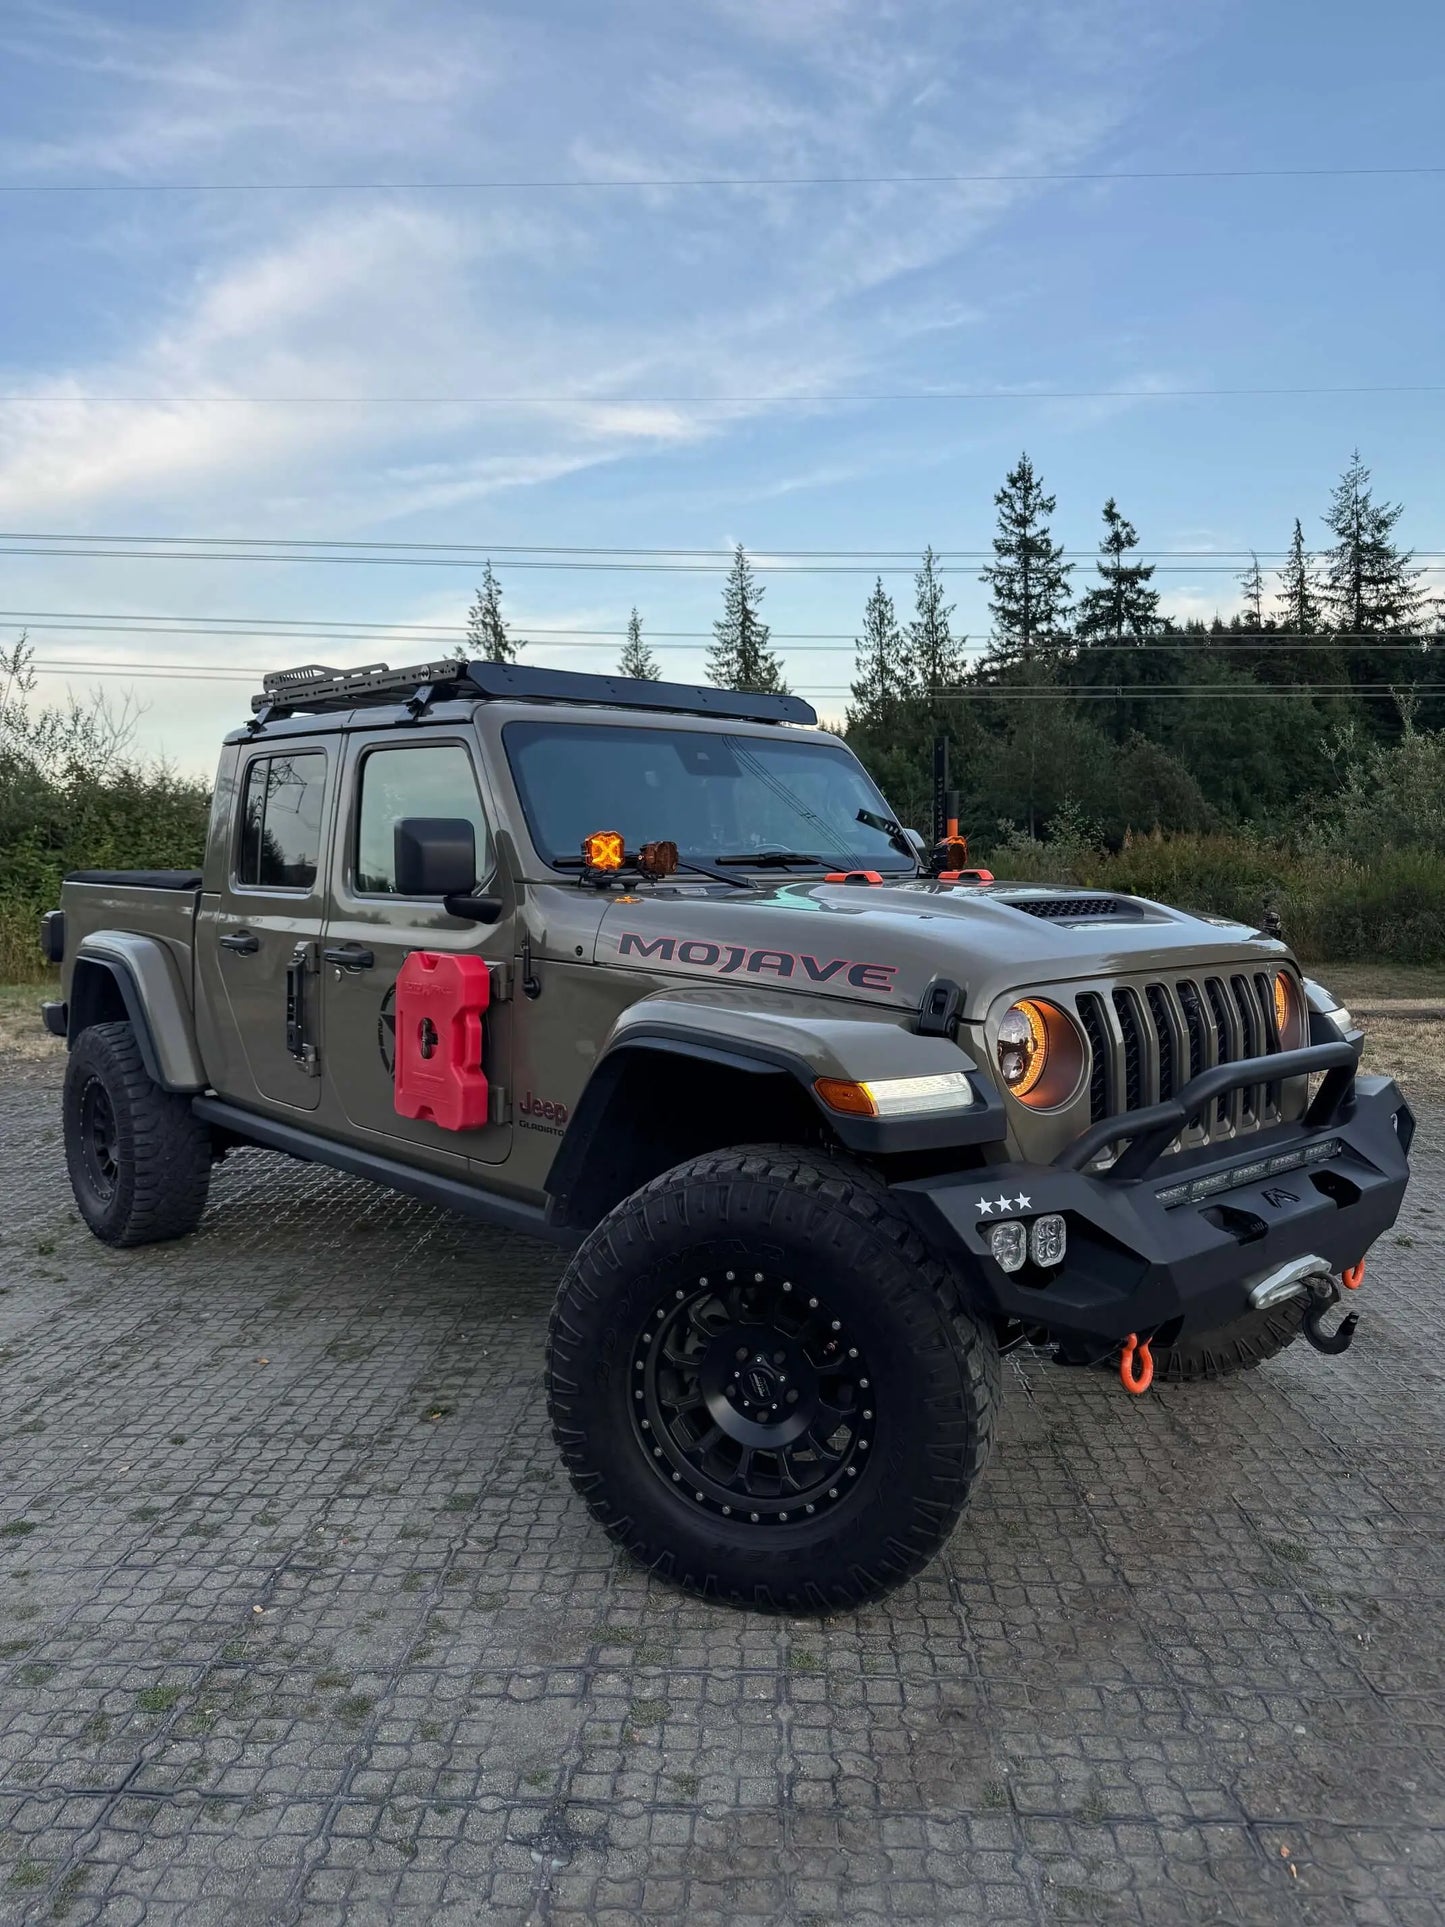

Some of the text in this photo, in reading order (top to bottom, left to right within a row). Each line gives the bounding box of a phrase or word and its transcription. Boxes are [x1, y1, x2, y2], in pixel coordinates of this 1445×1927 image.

[618, 932, 898, 992] MOJAVE
[519, 1090, 568, 1127] Jeep
[519, 1120, 565, 1137] GLADIATO
